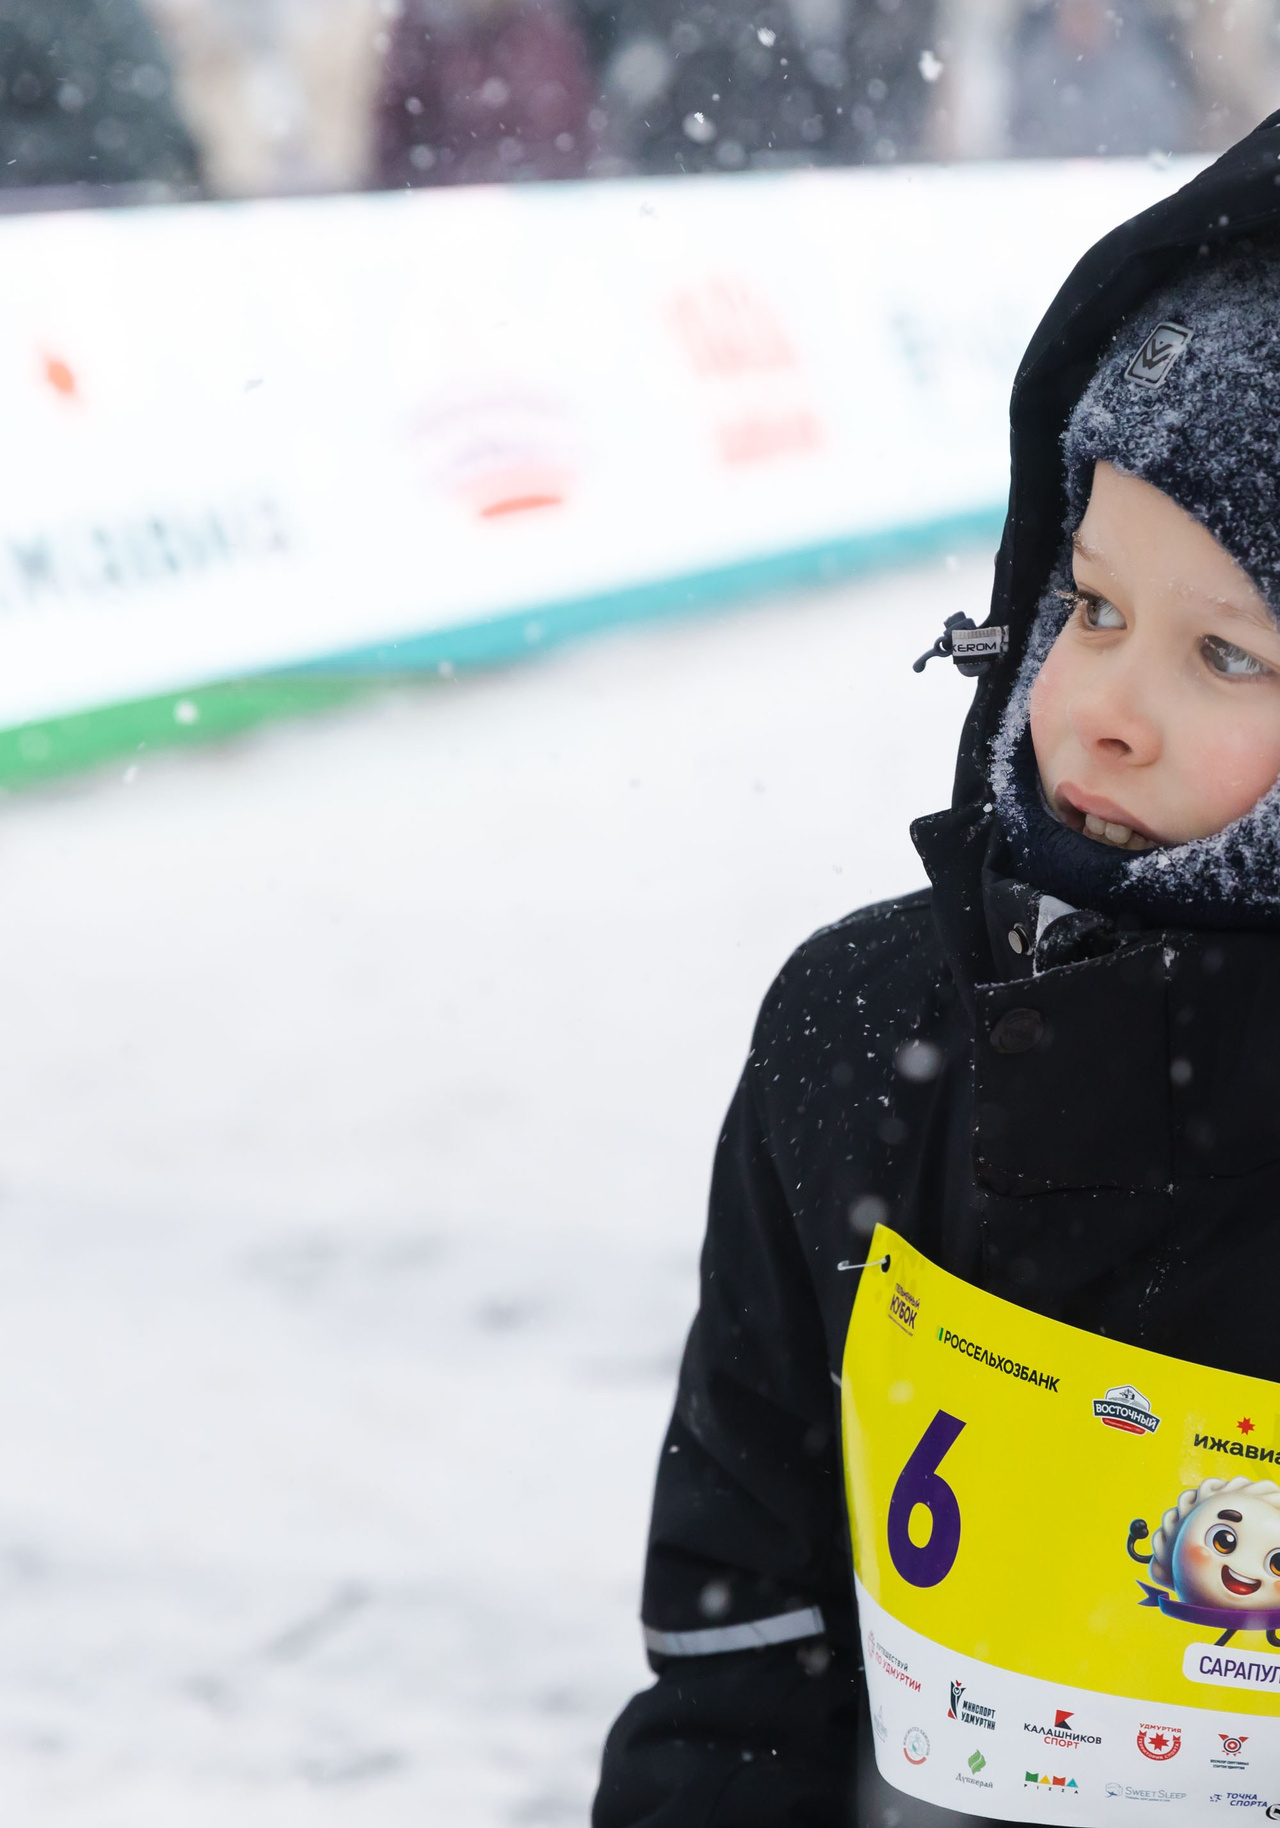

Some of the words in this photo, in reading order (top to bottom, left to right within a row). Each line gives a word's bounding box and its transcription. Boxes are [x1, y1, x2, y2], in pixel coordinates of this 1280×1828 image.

[889, 1293, 918, 1330] КУБОК
[943, 1330, 1061, 1393] РОССЕЛЬХОЗБАНК
[1095, 1403, 1157, 1430] ВОСТОЧНЫЙ
[887, 1409, 967, 1588] 6
[883, 1661, 922, 1692] УДМУРТИИ
[962, 1700, 996, 1719] МИНСПОРТ
[961, 1711, 996, 1731] УДМУРТИИ
[1139, 1722, 1182, 1733] УДМУРТИЯ
[1023, 1722, 1102, 1745] КАЛАШНИКОВ
[1043, 1736, 1080, 1750] СПОРТ
[1226, 1792, 1258, 1800] ТОЧКА
[1229, 1800, 1268, 1808] СПОРТА
